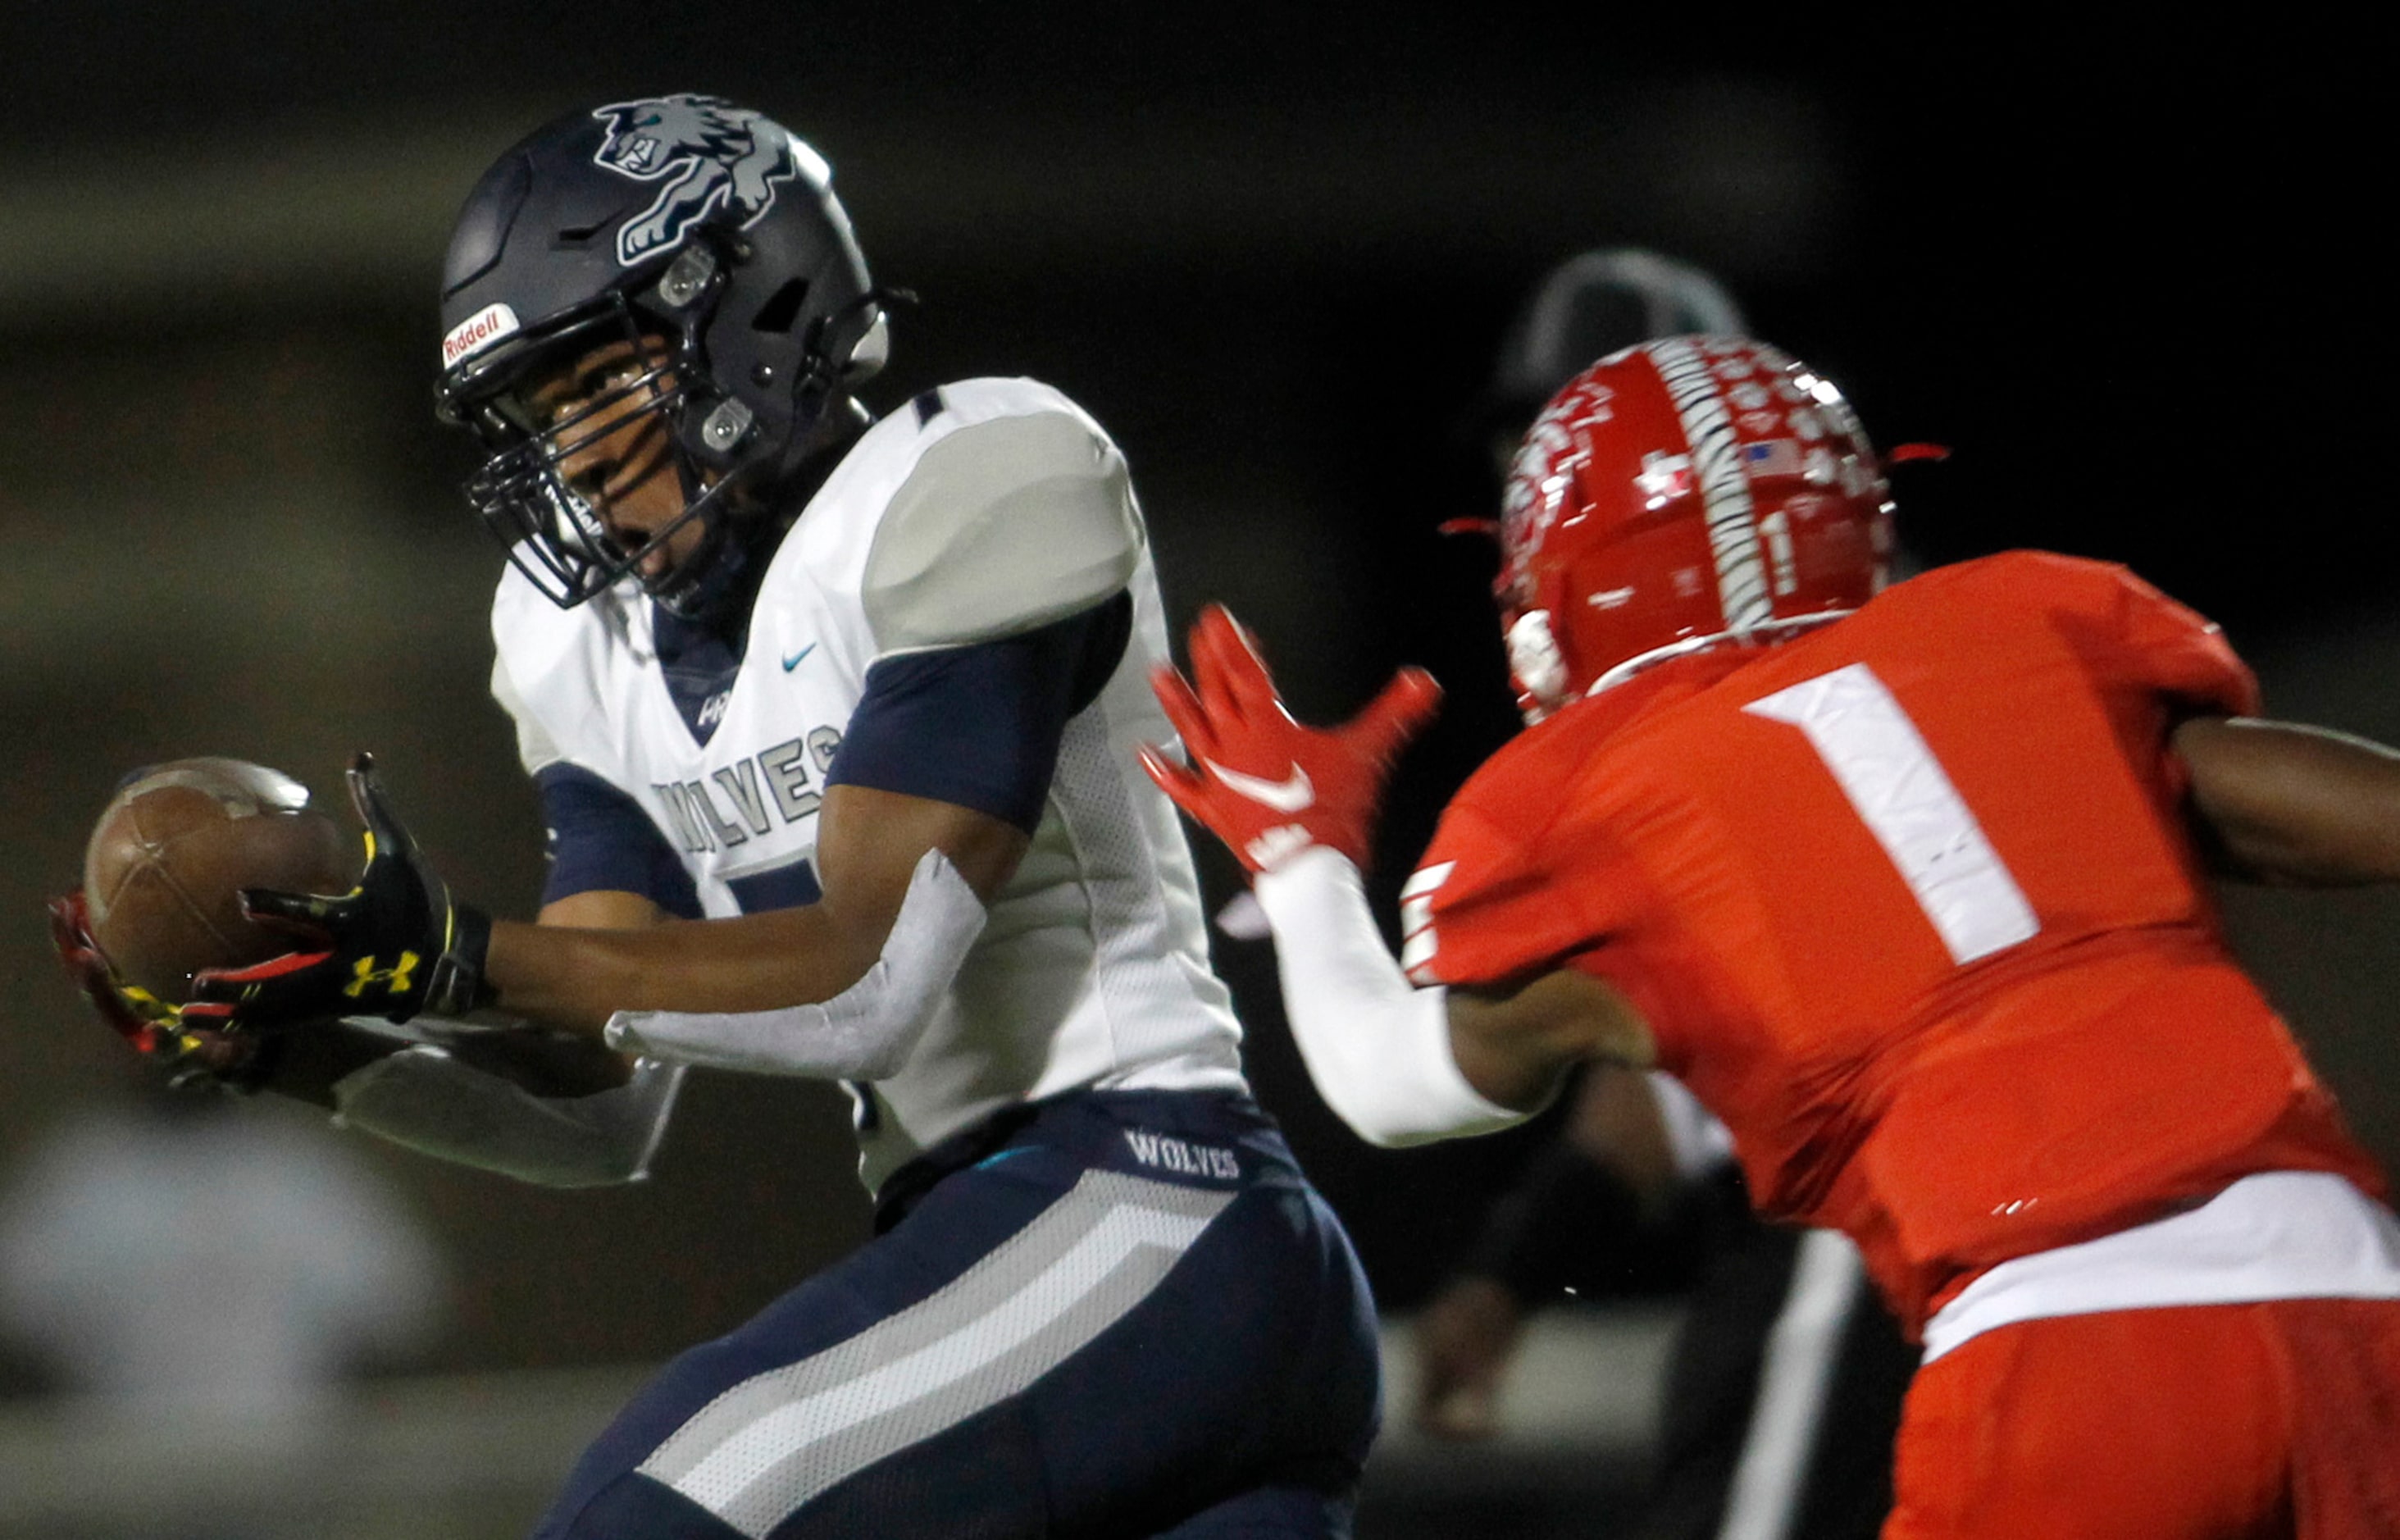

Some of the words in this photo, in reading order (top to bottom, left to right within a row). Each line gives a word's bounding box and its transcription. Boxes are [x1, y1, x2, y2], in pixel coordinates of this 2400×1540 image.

[444, 312, 499, 361] Riddell
[650, 724, 845, 852] WLVE
[1739, 662, 2042, 966] 1
[1123, 1129, 1239, 1178] WOLVES
